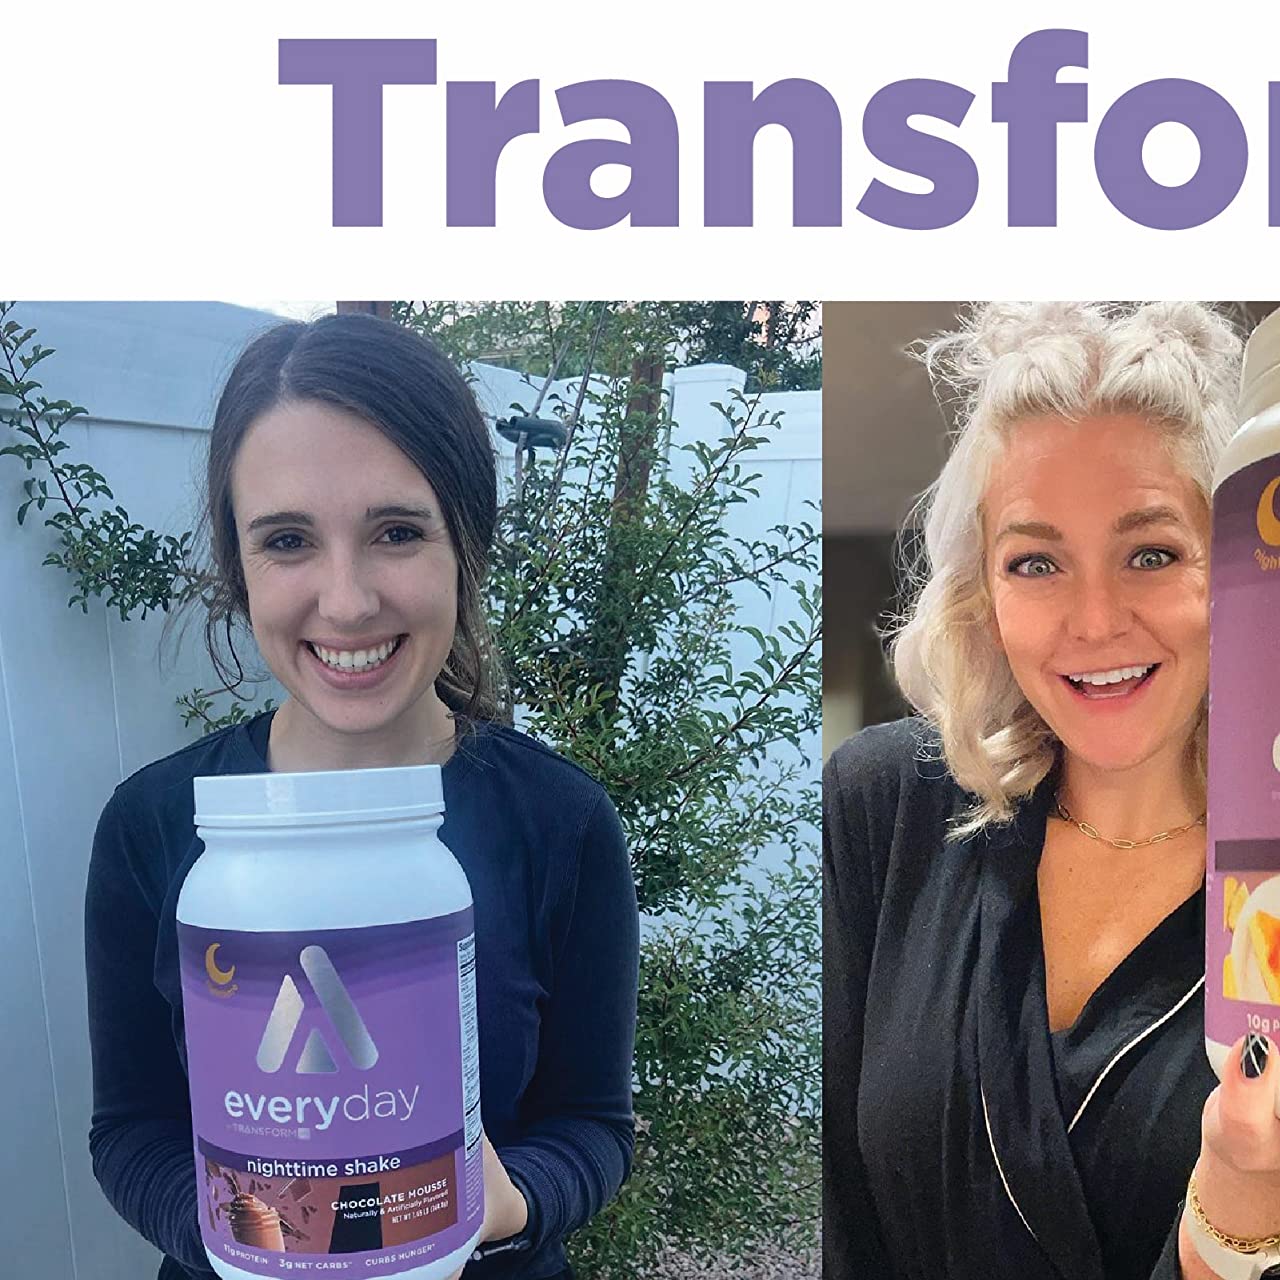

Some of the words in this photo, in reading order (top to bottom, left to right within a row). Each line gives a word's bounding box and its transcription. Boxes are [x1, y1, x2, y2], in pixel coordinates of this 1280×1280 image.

[1246, 1013, 1270, 1034] 10g
[224, 1083, 420, 1130] everyday
[247, 1158, 339, 1178] nighttime
[344, 1155, 401, 1176] shake
[331, 1192, 405, 1211] CHOCOLATE
[408, 1178, 448, 1199] MOUSSE
[343, 1209, 378, 1219] Naturally
[235, 1251, 268, 1265] PROTEIN
[279, 1258, 293, 1270] 3g
[294, 1261, 313, 1269] NET
[365, 1254, 396, 1266] CURBS
